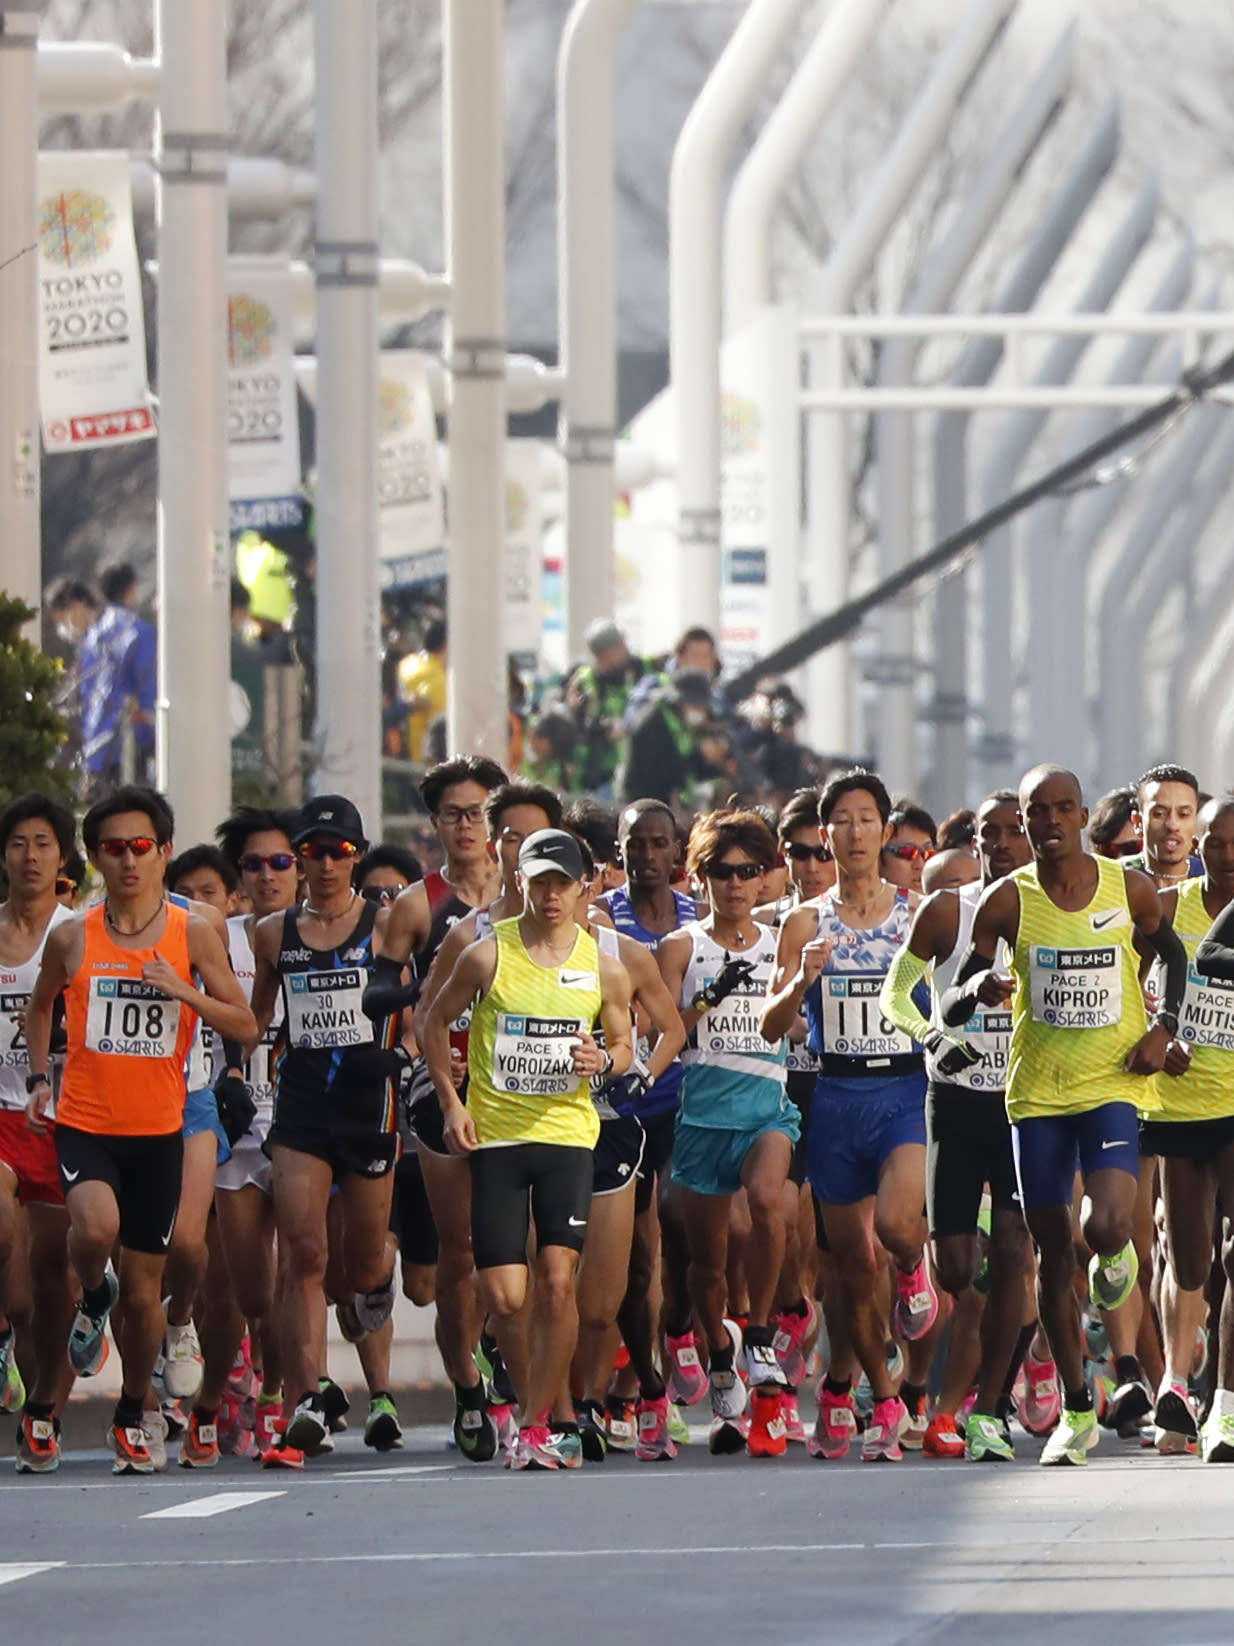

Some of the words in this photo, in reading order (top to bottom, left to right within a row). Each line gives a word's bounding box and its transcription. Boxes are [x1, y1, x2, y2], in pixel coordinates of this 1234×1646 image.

[42, 271, 122, 297] TOKYO
[47, 307, 128, 338] 2020
[1060, 952, 1113, 967] 東京メトロ
[310, 974, 357, 988] 東京メトロ
[1051, 974, 1087, 987] PACE
[1094, 975, 1101, 987] 2
[121, 983, 168, 997] 東京メト
[1043, 987, 1109, 1008] KIPROP
[318, 994, 333, 1009] 30
[734, 1000, 751, 1014] 28
[1197, 991, 1234, 1009] PACE
[104, 1001, 164, 1038] 108
[301, 1009, 356, 1030] KAWAI
[528, 1022, 577, 1035] 東京メトロ
[516, 1042, 551, 1055] PACE
[981, 1051, 1010, 1069] AB
